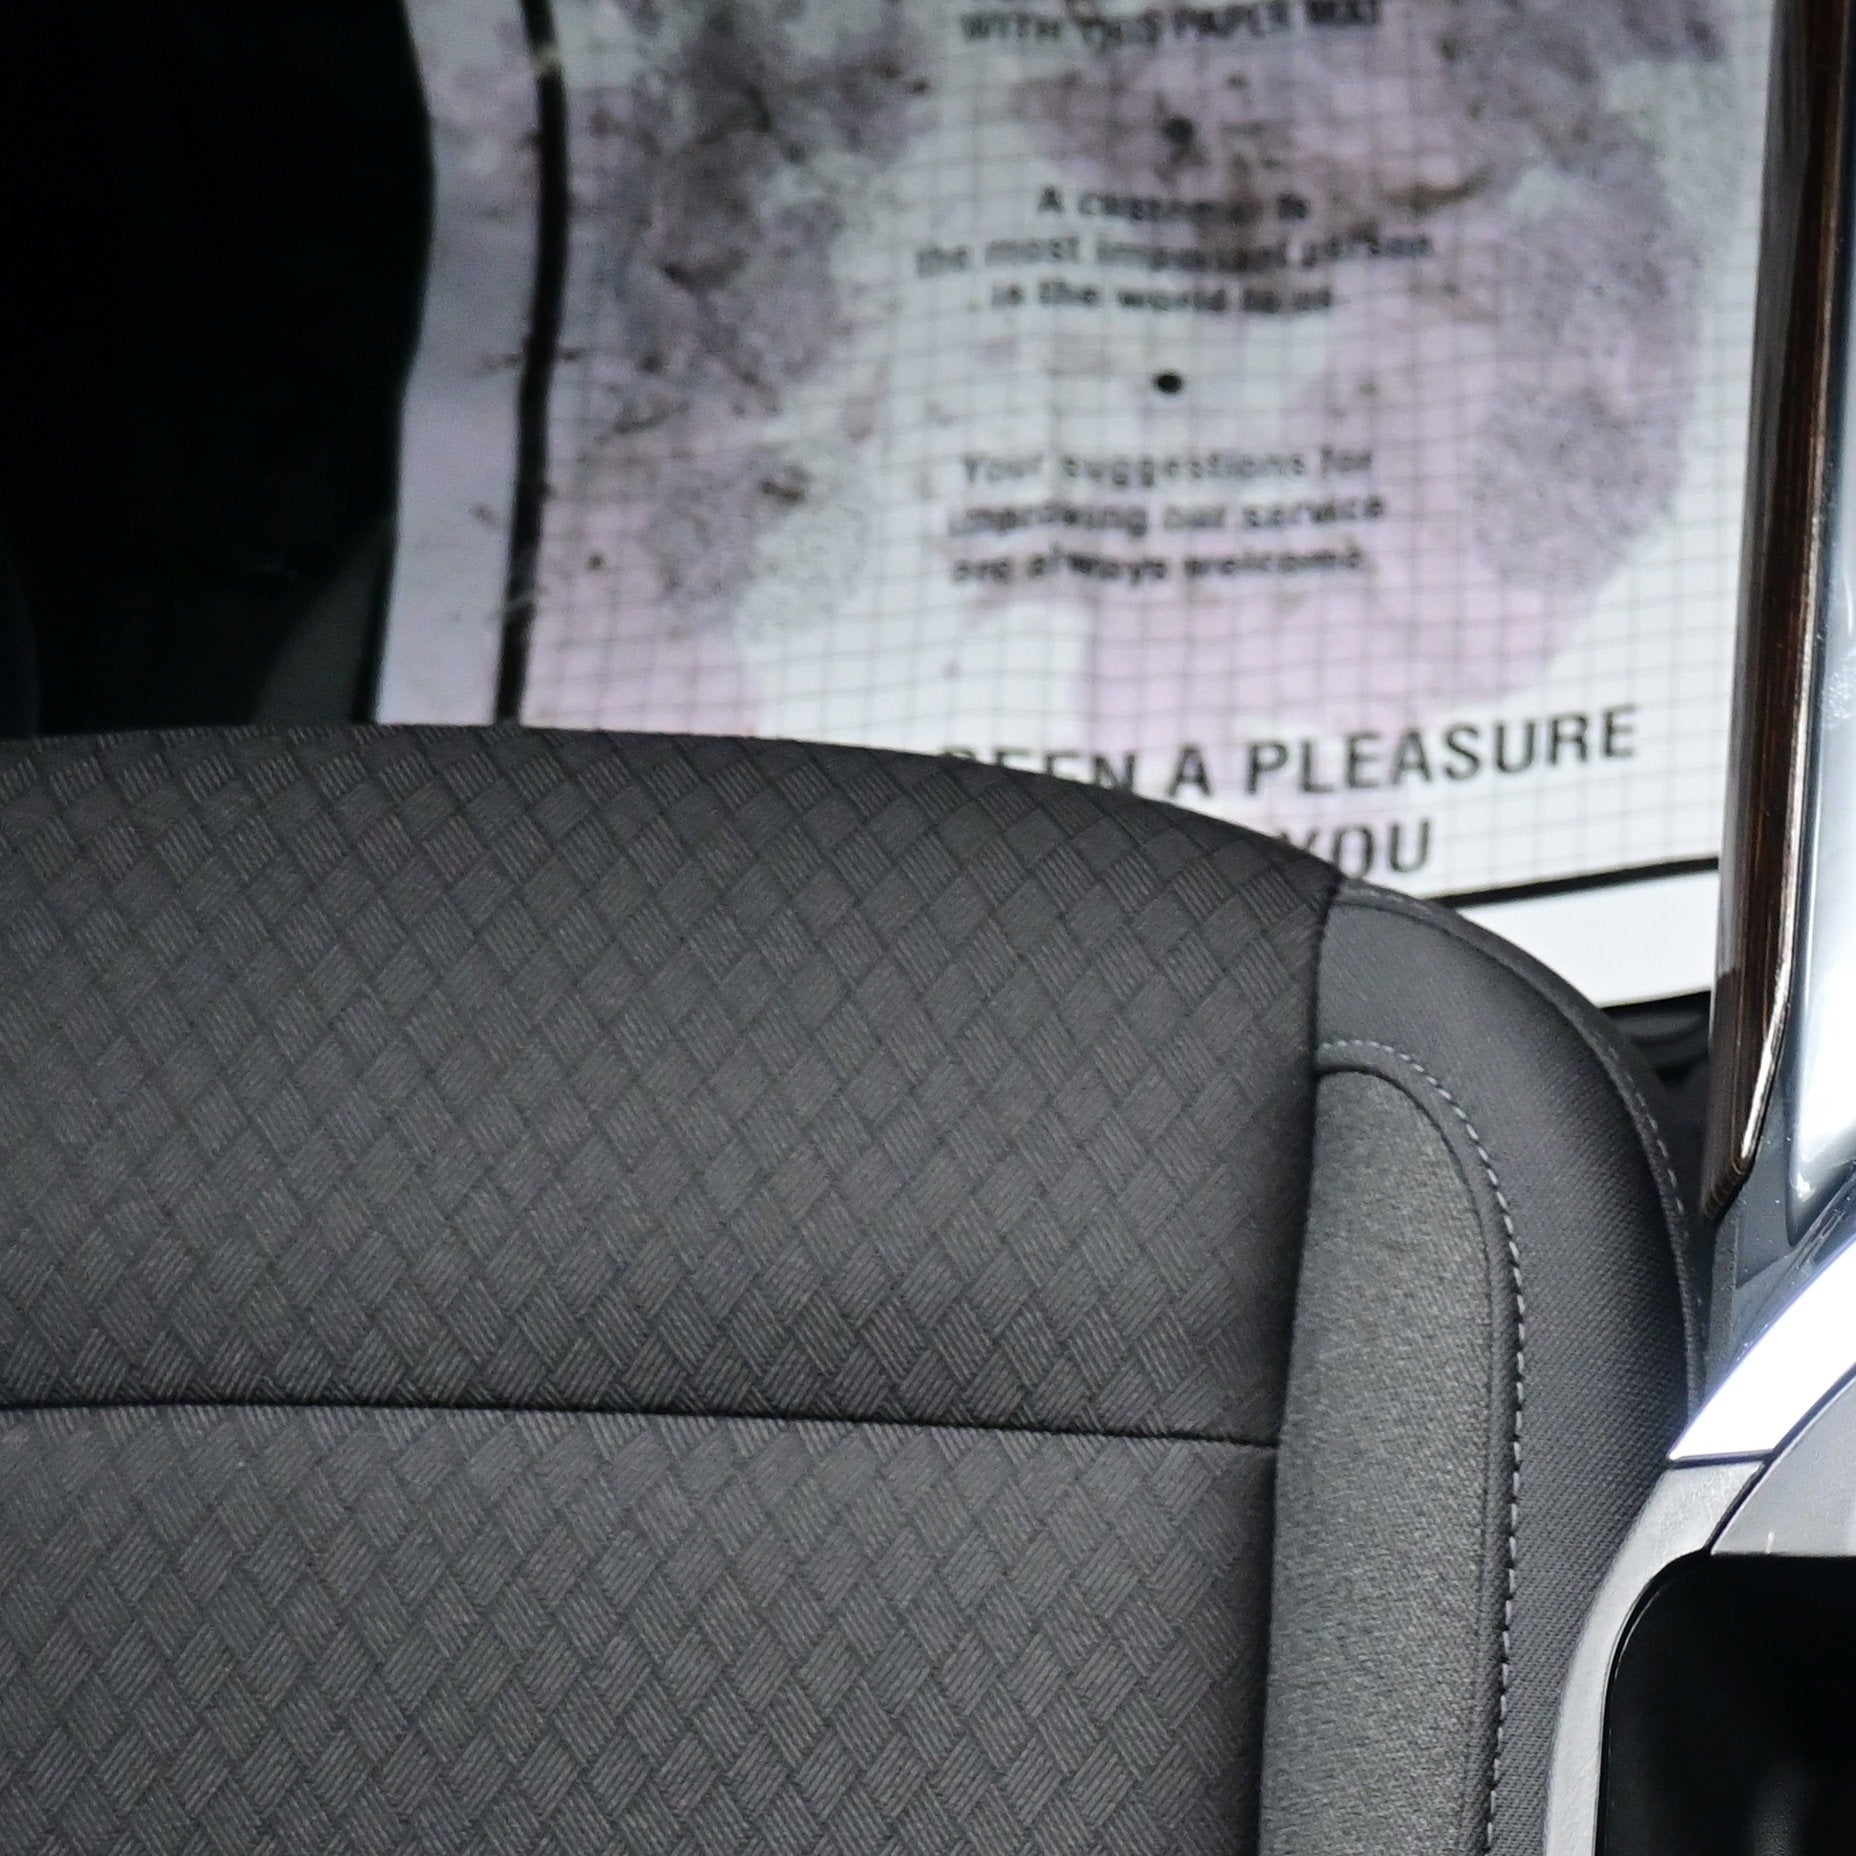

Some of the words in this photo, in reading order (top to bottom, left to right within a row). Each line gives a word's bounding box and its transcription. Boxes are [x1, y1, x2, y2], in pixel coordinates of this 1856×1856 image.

[1037, 185, 1064, 214] A
[1168, 742, 1213, 797] A
[1246, 704, 1637, 796] PLEASURE
